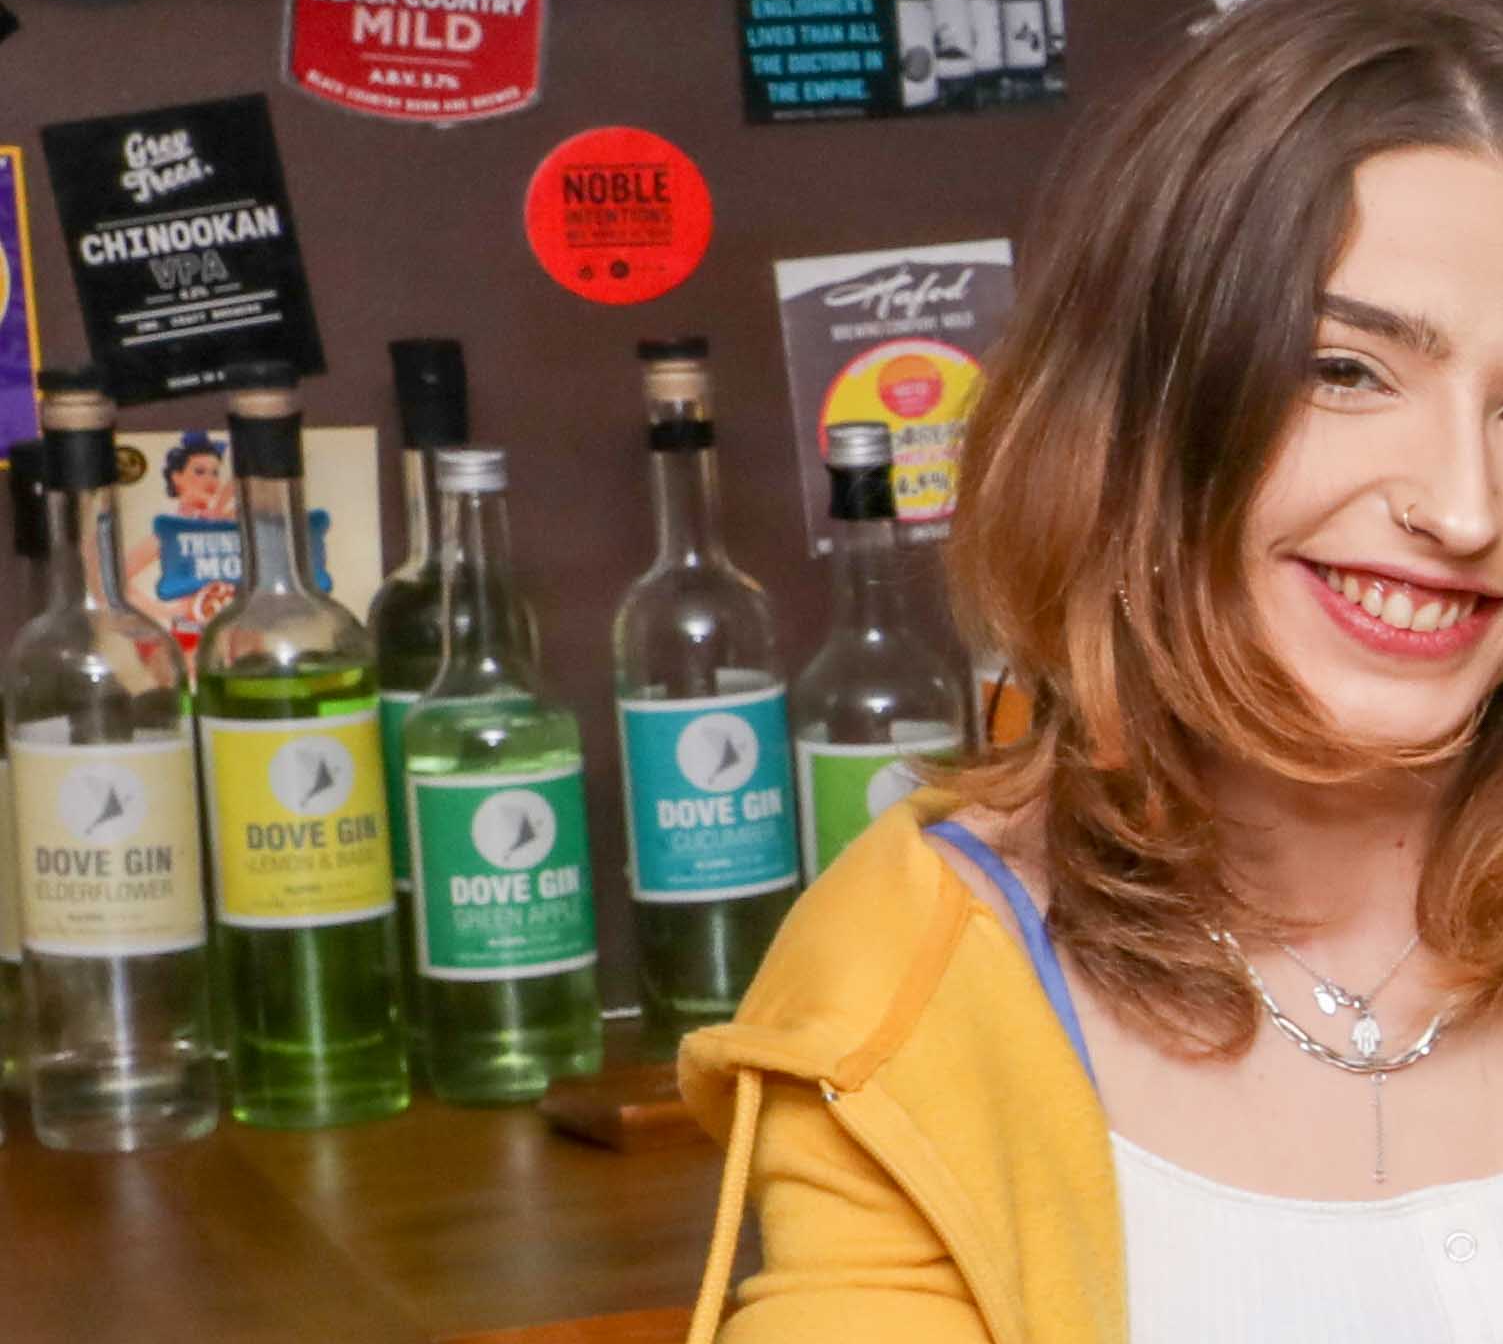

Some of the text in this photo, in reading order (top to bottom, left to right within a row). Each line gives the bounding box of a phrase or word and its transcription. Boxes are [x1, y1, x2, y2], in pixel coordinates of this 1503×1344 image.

[351, 5, 484, 53] MILD
[848, 21, 881, 43] ALL
[124, 129, 194, 170] Grey
[561, 170, 672, 205] NOBLE
[80, 204, 282, 267] CHINOOKAN
[148, 248, 230, 291] VPA
[824, 262, 975, 320] Hafod
[656, 788, 783, 831] DOVE GIN
[246, 813, 378, 851] DOVE GIN
[36, 846, 174, 877] DOVE GIN
[34, 878, 174, 902] ELDERFLOWER
[450, 866, 581, 907] DOVE GIN
[453, 906, 524, 930] GREEN
